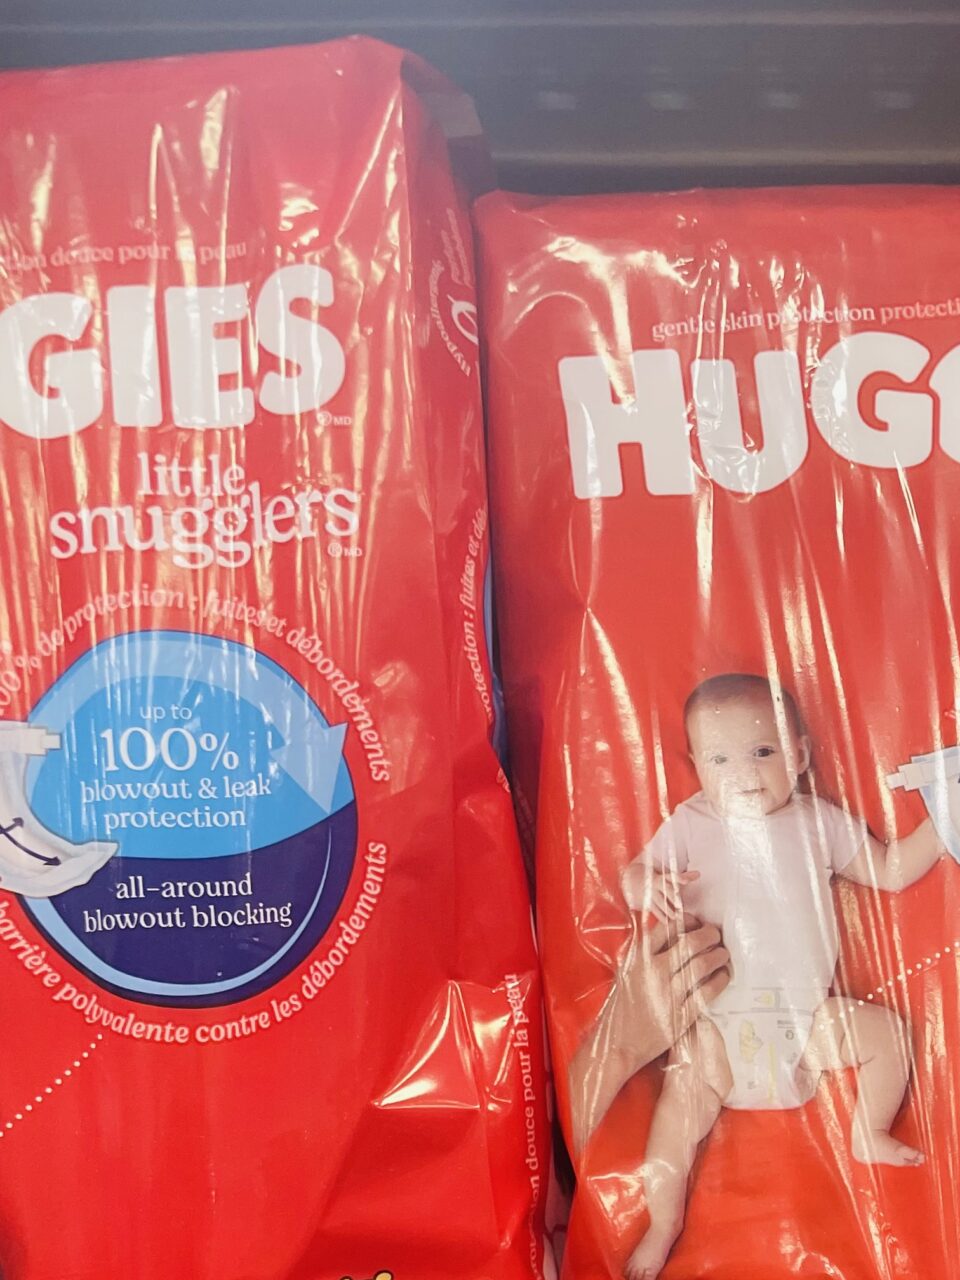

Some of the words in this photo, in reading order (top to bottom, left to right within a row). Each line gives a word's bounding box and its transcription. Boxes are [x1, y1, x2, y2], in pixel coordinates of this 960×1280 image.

[722, 311, 762, 332] skin
[0, 265, 345, 439] GIES
[137, 452, 246, 497] little
[50, 481, 359, 569] snugglers
[140, 706, 165, 723] up
[171, 703, 193, 720] to
[286, 627, 391, 781] débordements
[101, 727, 239, 771] 100%
[80, 779, 192, 804] blowout
[198, 777, 219, 799] &
[224, 773, 272, 798] leak
[104, 806, 246, 835] protection
[116, 872, 252, 899] all-around
[84, 906, 185, 932] blowout
[192, 903, 293, 928] blocking
[53, 981, 189, 1044] polyvalente
[196, 1008, 270, 1043] contre
[272, 991, 302, 1022] les
[301, 842, 388, 1000] débordements
[514, 1050, 534, 1104] pour
[524, 1106, 540, 1170] douce
